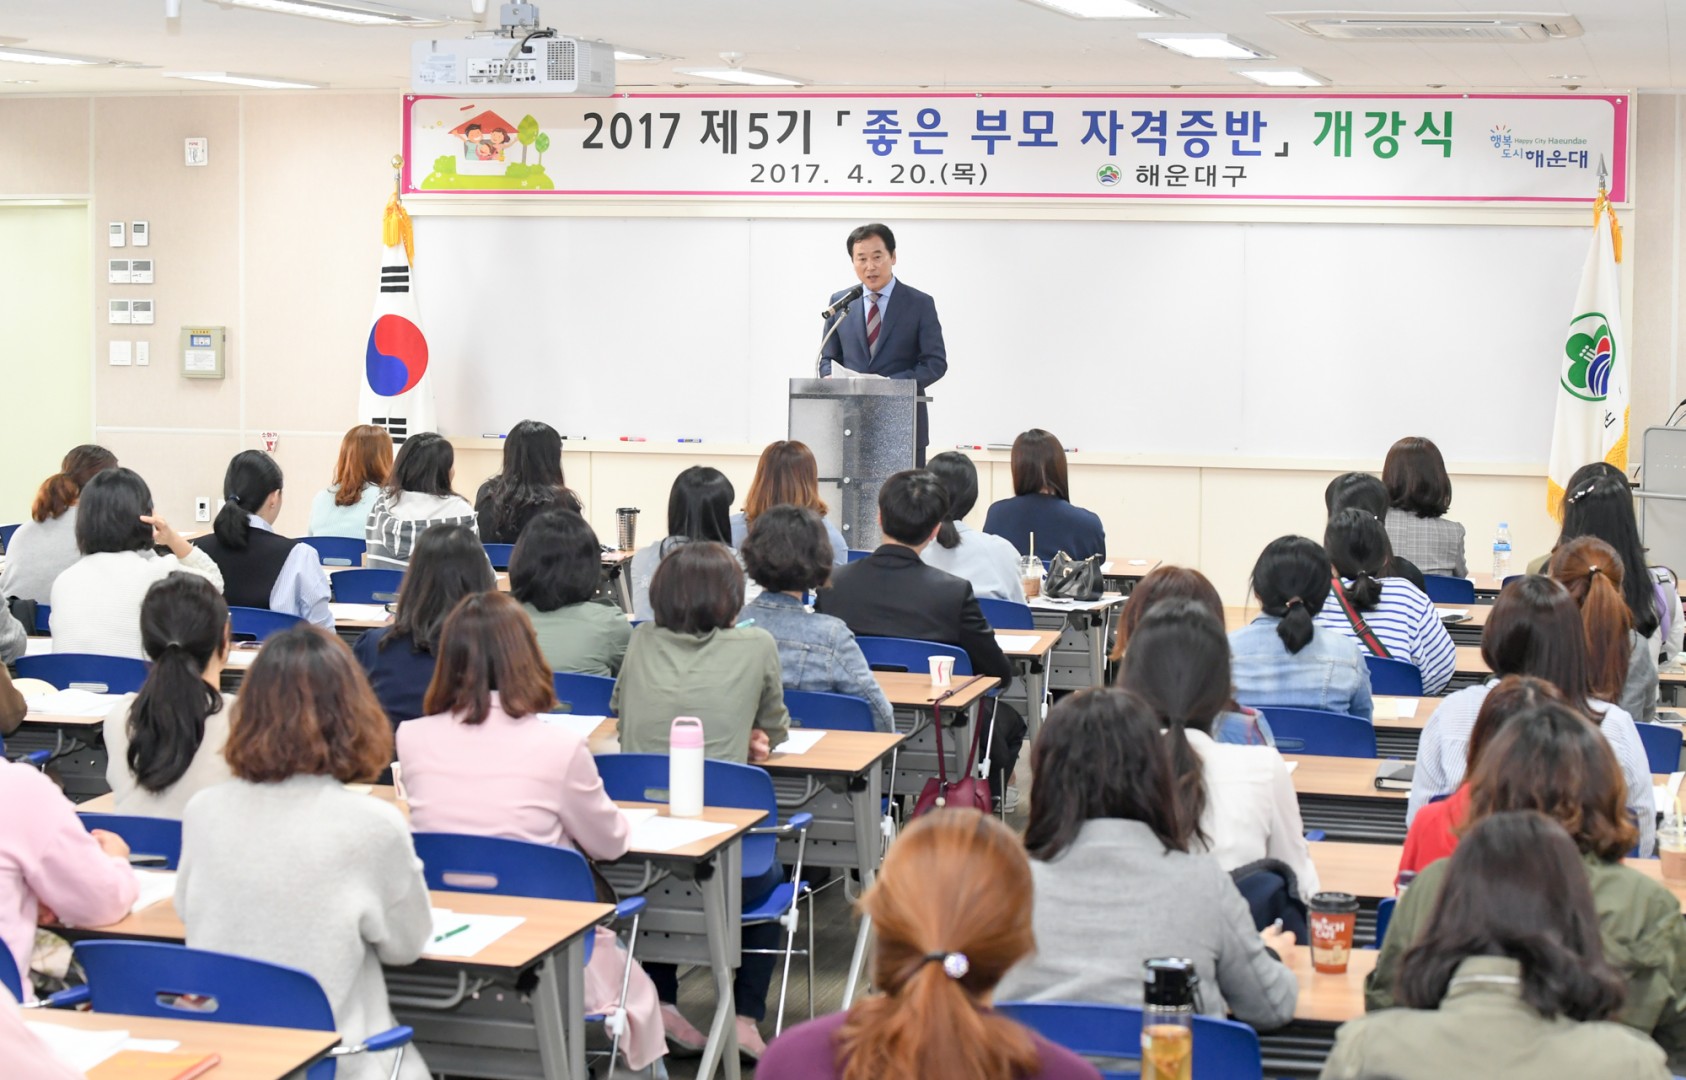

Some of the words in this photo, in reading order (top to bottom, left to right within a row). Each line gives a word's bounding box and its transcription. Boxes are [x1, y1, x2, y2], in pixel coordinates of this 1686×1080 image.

[582, 112, 681, 149] 2017
[699, 109, 812, 155] 제5기
[971, 110, 1059, 155] 부모
[1313, 110, 1453, 159] 개강식
[1490, 134, 1513, 149] 행복
[1535, 137, 1547, 145] City
[1548, 137, 1587, 145] Haeundae
[1501, 148, 1524, 159] 도시
[1525, 150, 1588, 168] 해운대
[1135, 164, 1248, 188] 해운대구
